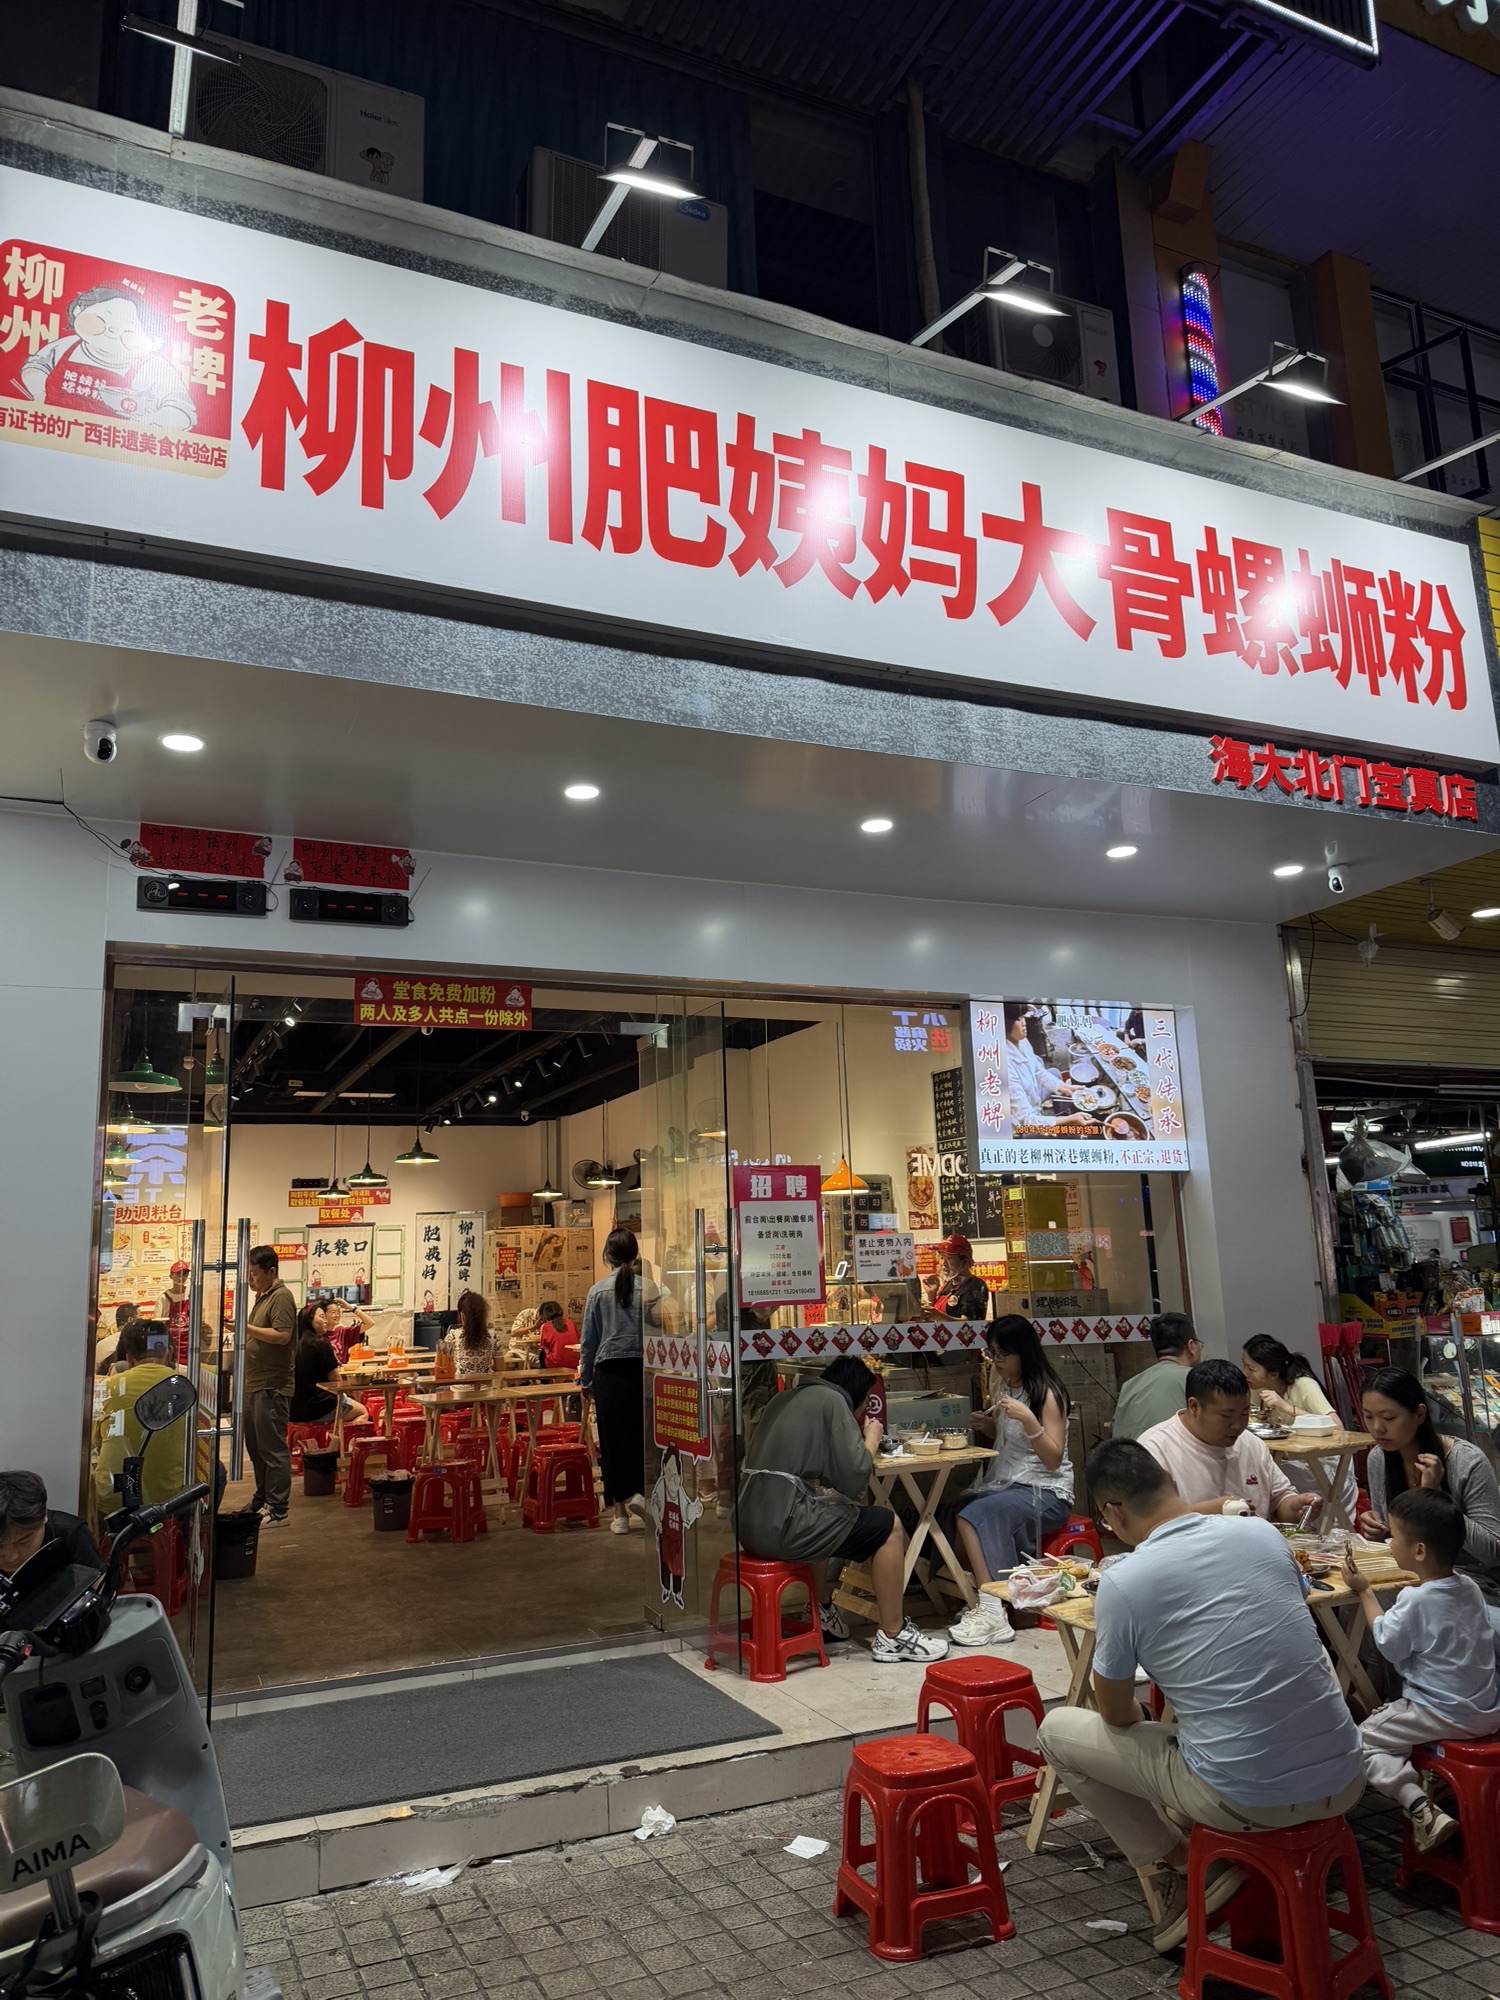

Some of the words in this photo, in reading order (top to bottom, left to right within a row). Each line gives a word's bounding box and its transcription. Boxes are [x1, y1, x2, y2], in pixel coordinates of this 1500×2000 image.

[0, 246, 65, 355] 柳州
[172, 288, 229, 396] 老牌
[241, 299, 1466, 712] 柳州肥姨妈大骨螺蛳粉
[1207, 734, 1479, 822] 海大北门宝真店
[359, 1003, 528, 1027] 两人及多人共点一份除外
[393, 980, 496, 1004] 堂食免费加粉
[975, 1009, 1005, 1133] 柳州老牌
[1151, 1018, 1183, 1135] 三代传承
[320, 1208, 350, 1219] 取餐处
[750, 1174, 807, 1198] 招聘
[312, 1238, 368, 1257] 取餐口
[422, 1225, 442, 1280] 肥姨妈
[456, 1220, 475, 1281] 柳州老牌
[859, 1237, 912, 1248] 禁止宠物入内
[12, 1833, 91, 1882] AIMA
